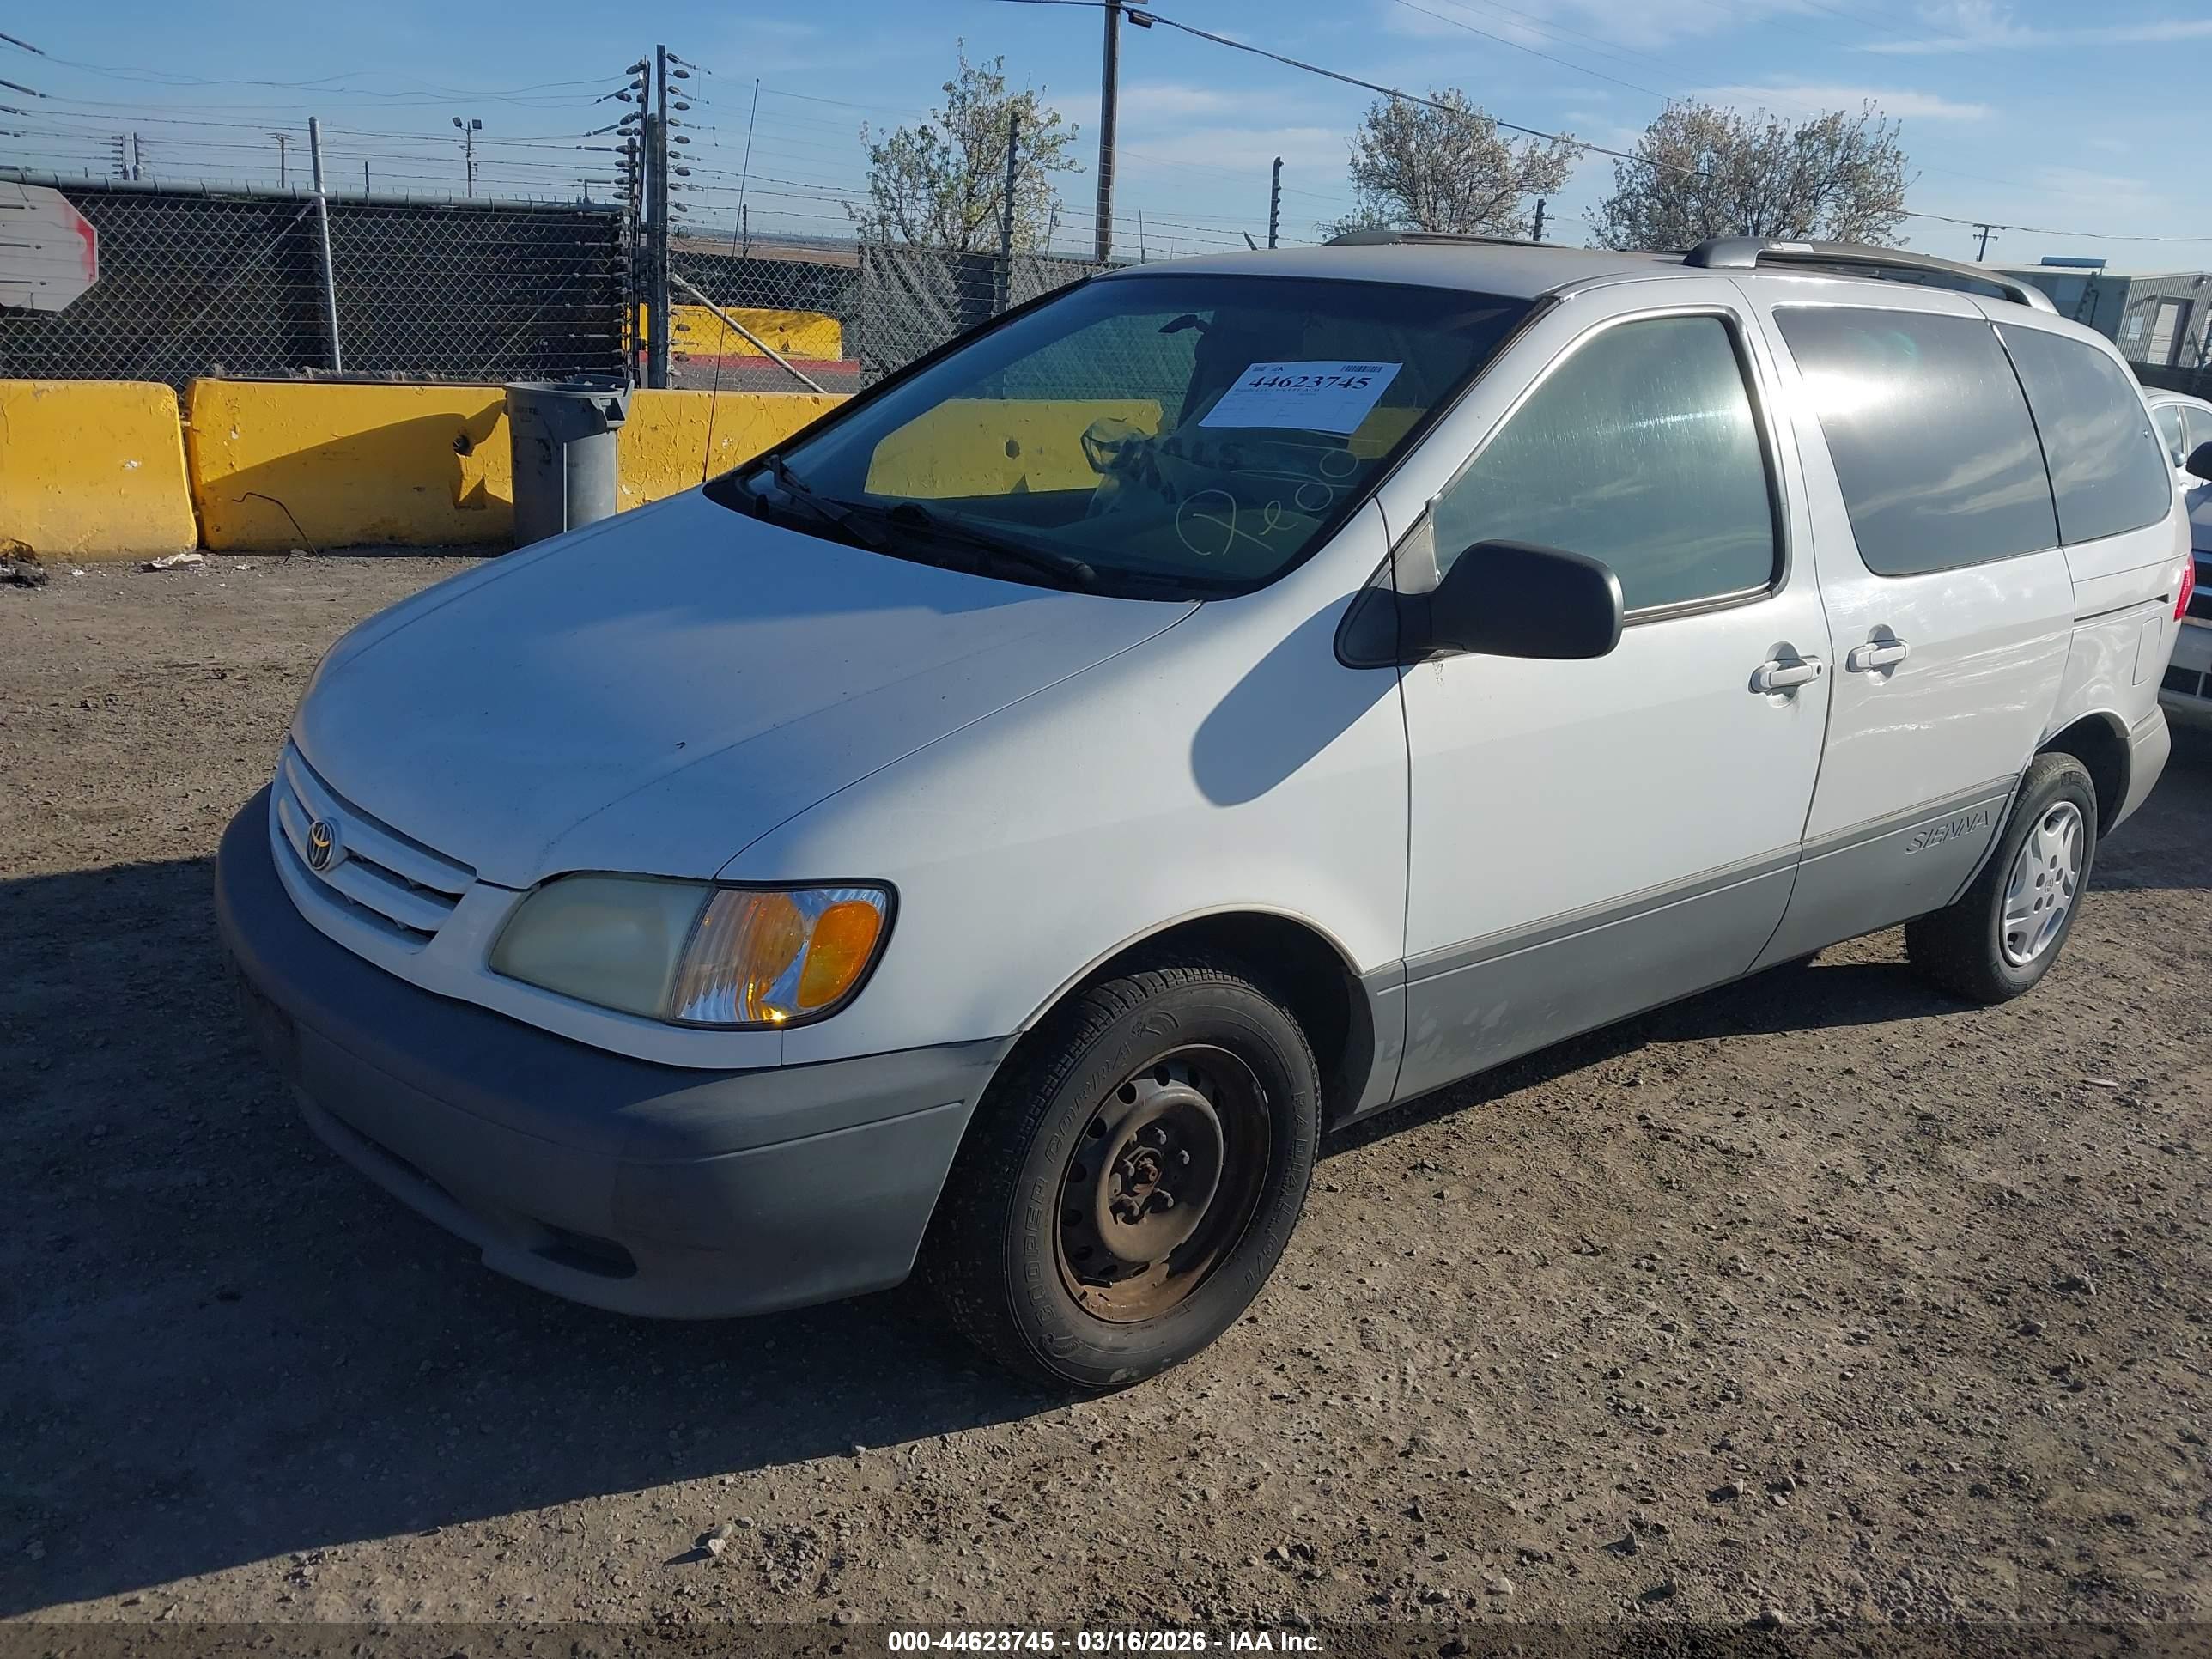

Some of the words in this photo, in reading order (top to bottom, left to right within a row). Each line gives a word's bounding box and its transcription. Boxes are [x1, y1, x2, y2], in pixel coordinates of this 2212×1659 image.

[1249, 375, 1373, 390] 44623745
[1905, 810, 1990, 855] SIENNA
[1277, 1090, 1309, 1220] RADIAL
[1023, 1176, 1057, 1327] COOPER
